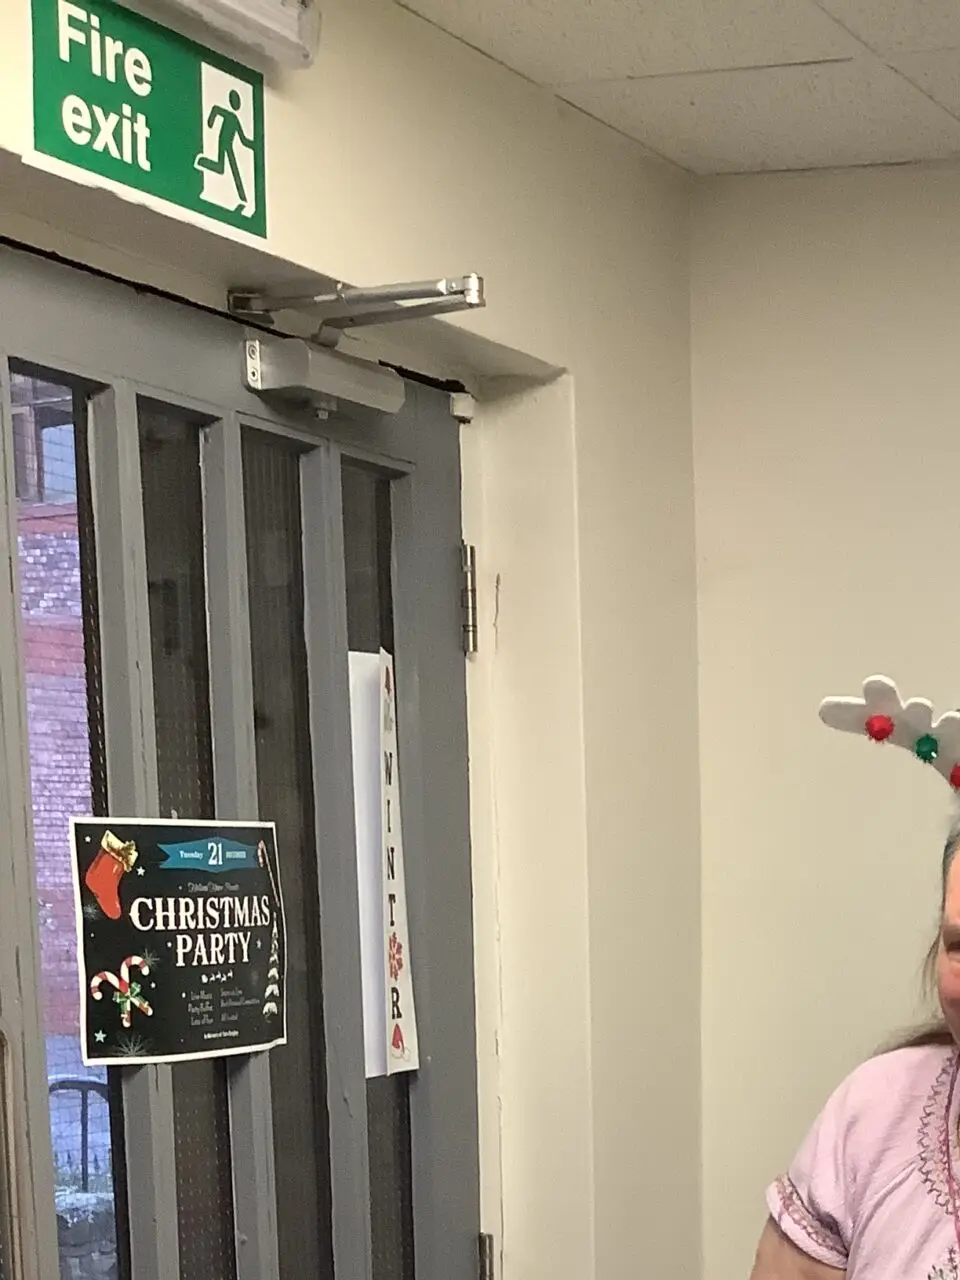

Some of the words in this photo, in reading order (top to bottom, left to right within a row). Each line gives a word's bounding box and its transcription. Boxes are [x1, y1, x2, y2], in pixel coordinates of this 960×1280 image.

[58, 0, 152, 97] Fire
[62, 95, 151, 172] exit
[207, 842, 223, 865] 21
[129, 895, 271, 932] CHRISTMAS
[175, 931, 251, 967] PARTY
